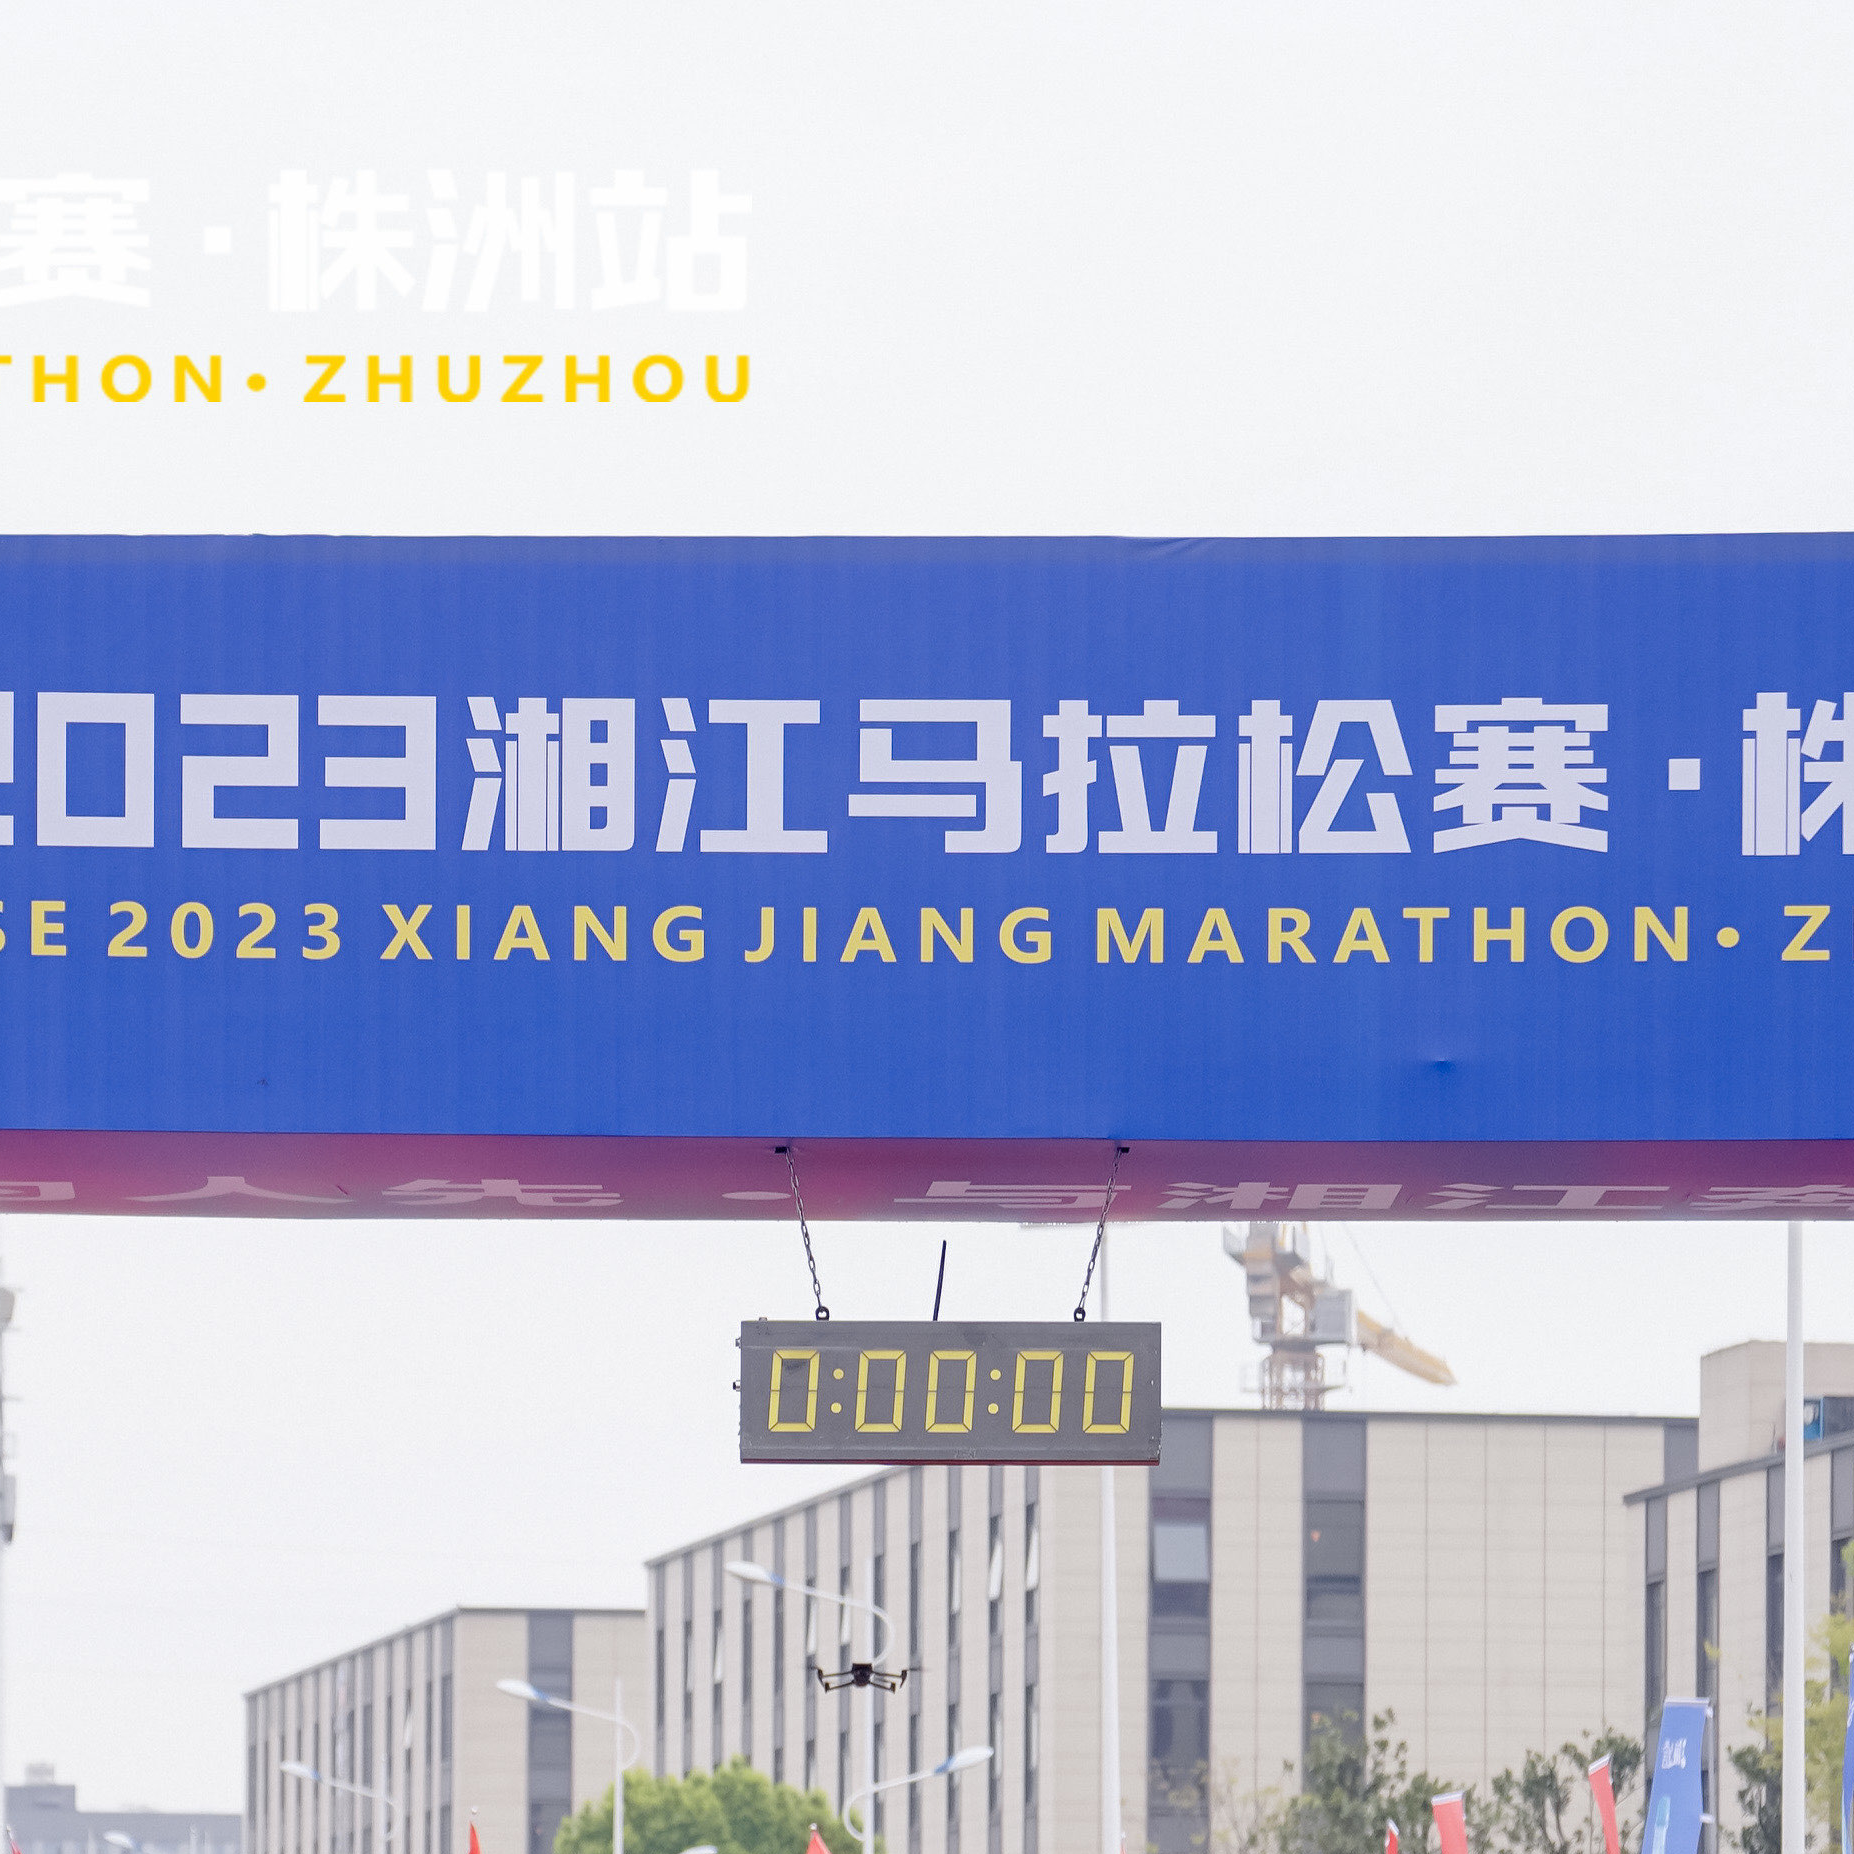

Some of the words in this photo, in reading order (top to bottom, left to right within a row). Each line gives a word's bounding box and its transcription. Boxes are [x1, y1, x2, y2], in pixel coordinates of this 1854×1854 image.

[107, 901, 342, 960] 2023
[381, 903, 708, 964] XIANG
[743, 905, 1053, 966] JIANG
[767, 1349, 1135, 1434] 0:00:00
